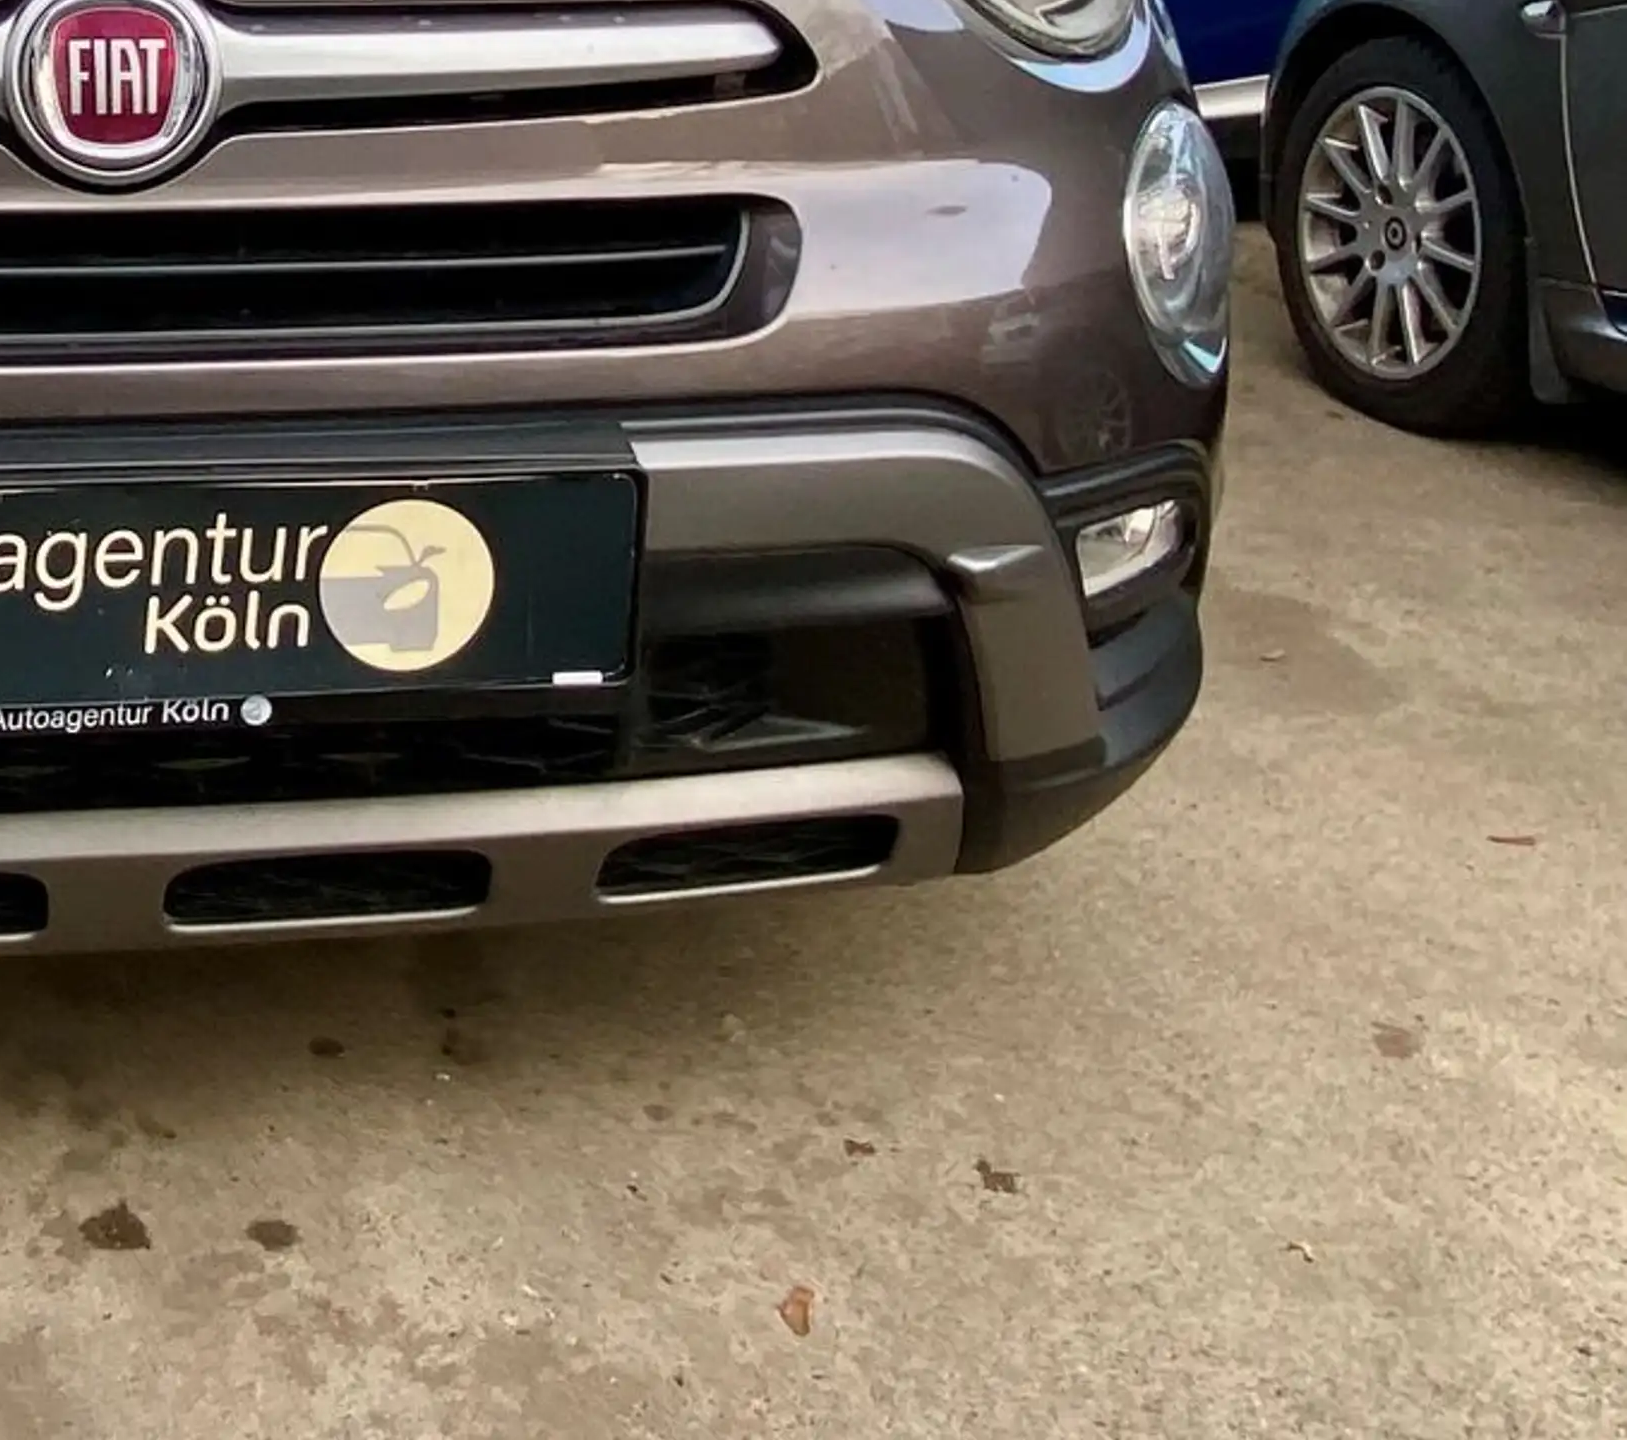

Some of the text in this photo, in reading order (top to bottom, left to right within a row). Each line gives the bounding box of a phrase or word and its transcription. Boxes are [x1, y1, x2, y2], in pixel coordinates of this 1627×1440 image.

[68, 37, 168, 116] FIAT
[143, 589, 312, 655] Köln
[161, 696, 230, 725] Köln
